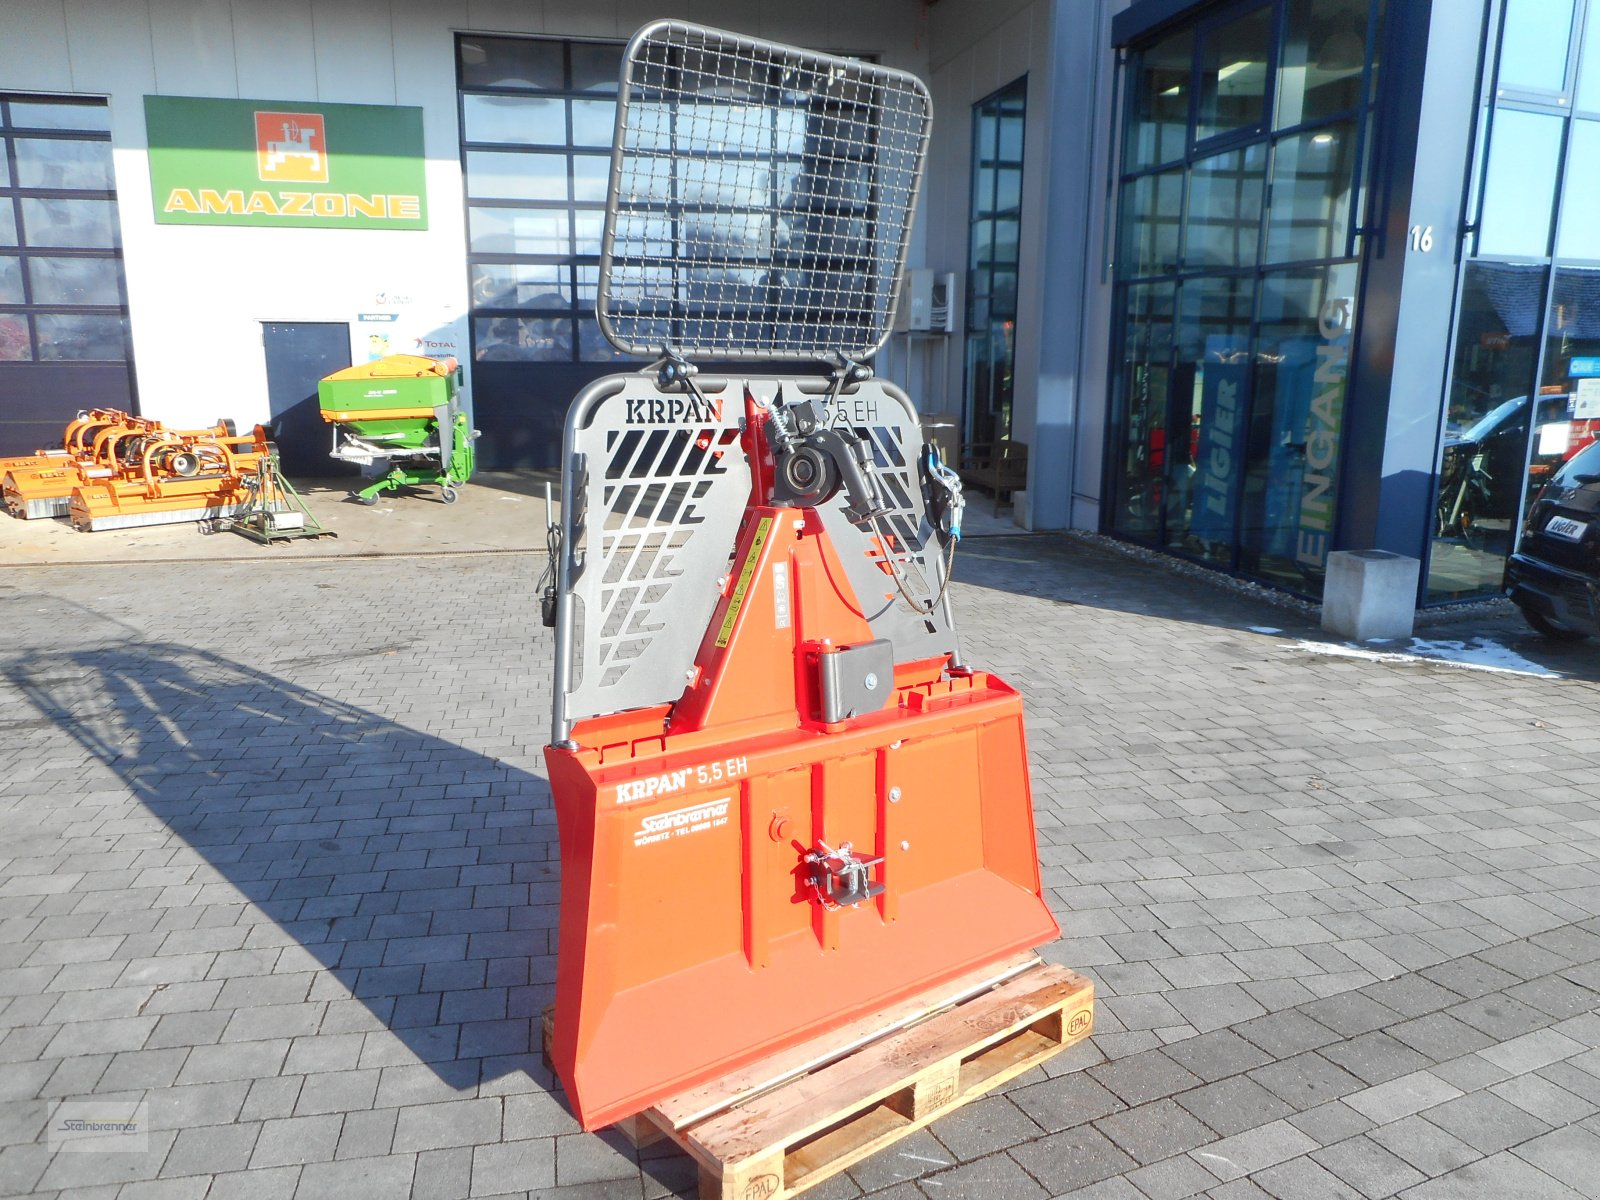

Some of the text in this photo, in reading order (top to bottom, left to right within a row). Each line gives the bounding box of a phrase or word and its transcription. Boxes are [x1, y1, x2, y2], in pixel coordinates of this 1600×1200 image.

[164, 188, 421, 220] AMAZONE
[1411, 224, 1433, 253] 16
[625, 399, 723, 424] KRPAN
[854, 400, 878, 422] EH
[1296, 298, 1350, 567] EINGANG
[697, 761, 723, 784] 5,5
[726, 755, 748, 778] EH
[1070, 1013, 1088, 1033] EPAL
